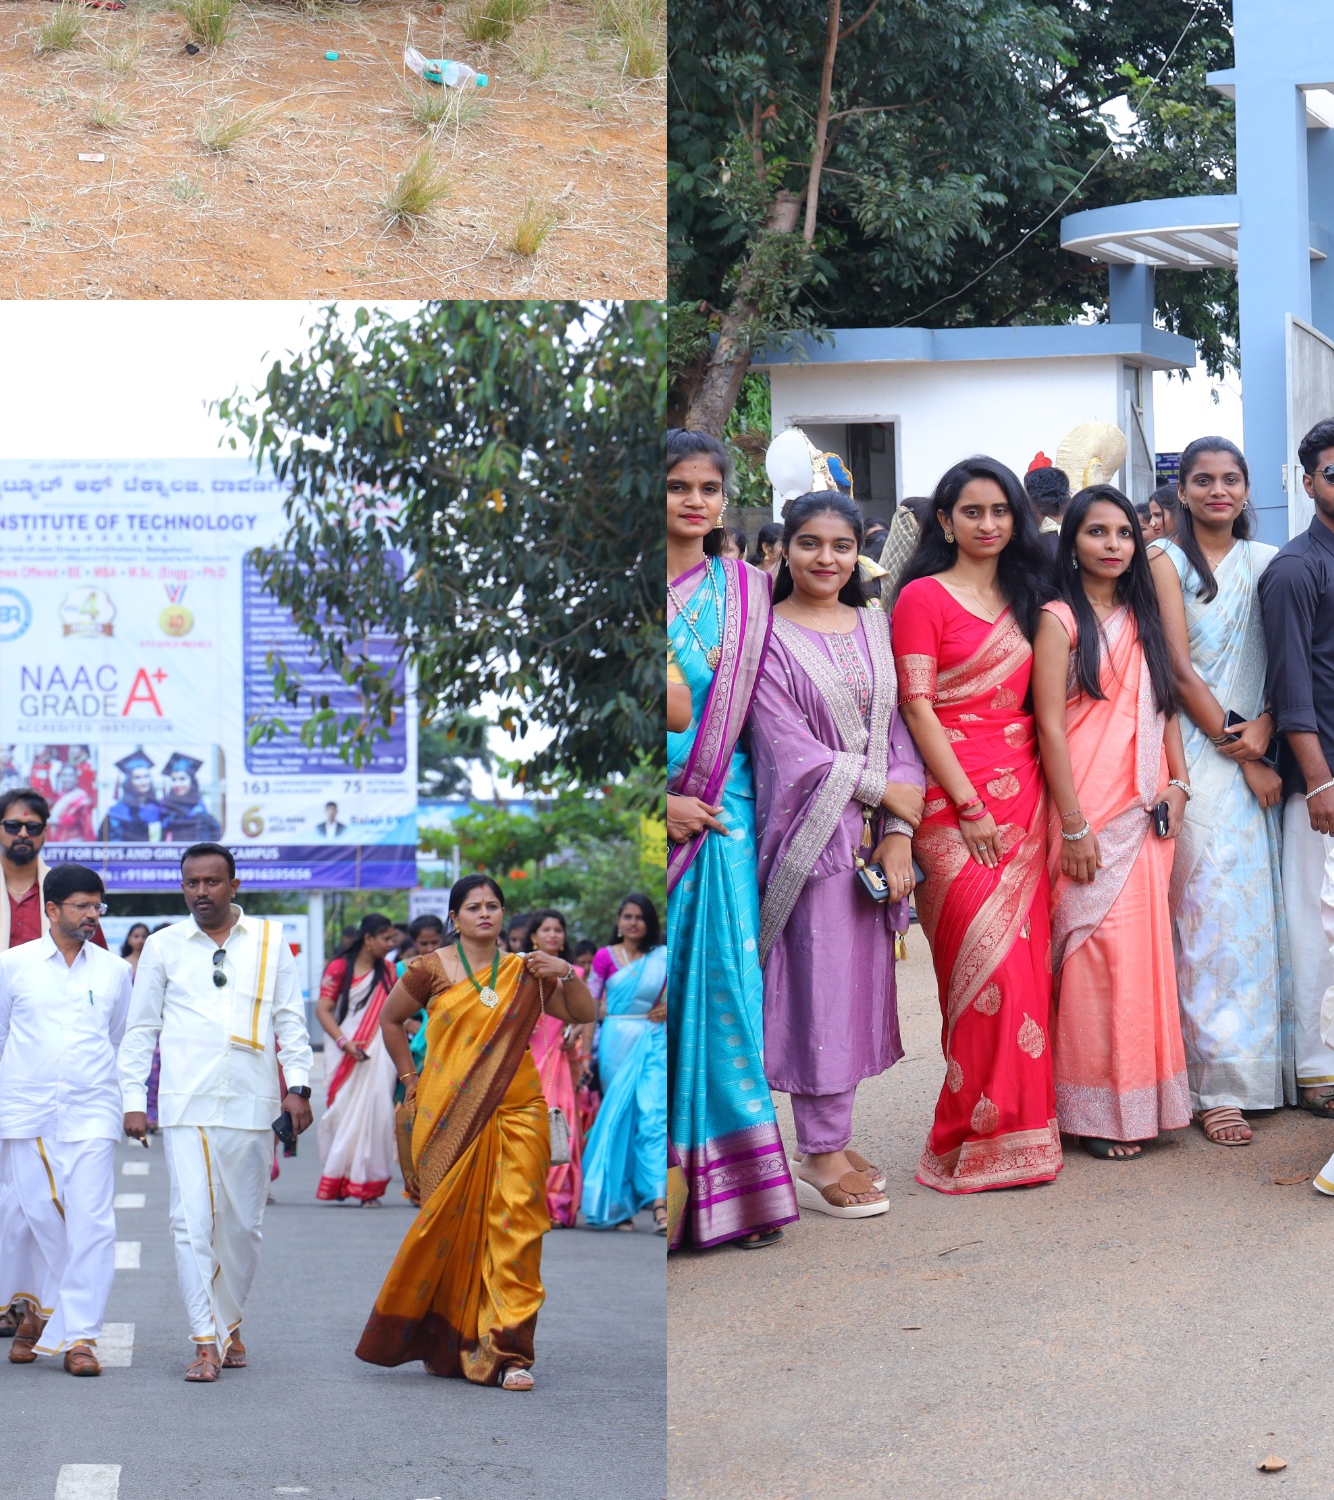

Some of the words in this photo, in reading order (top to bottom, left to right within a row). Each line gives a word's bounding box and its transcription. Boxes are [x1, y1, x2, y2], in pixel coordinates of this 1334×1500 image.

[95, 514, 120, 531] OF
[127, 514, 258, 531] TECHNOLOGY
[21, 566, 59, 579] Offered
[21, 665, 118, 692] NAAC
[122, 667, 168, 717] A+
[19, 695, 118, 717] GRADE
[242, 781, 270, 795] 163
[343, 780, 363, 794] 75
[241, 805, 265, 839] 6
[68, 847, 93, 861] FOR
[93, 847, 125, 861] BOYS
[126, 847, 154, 861] AND
